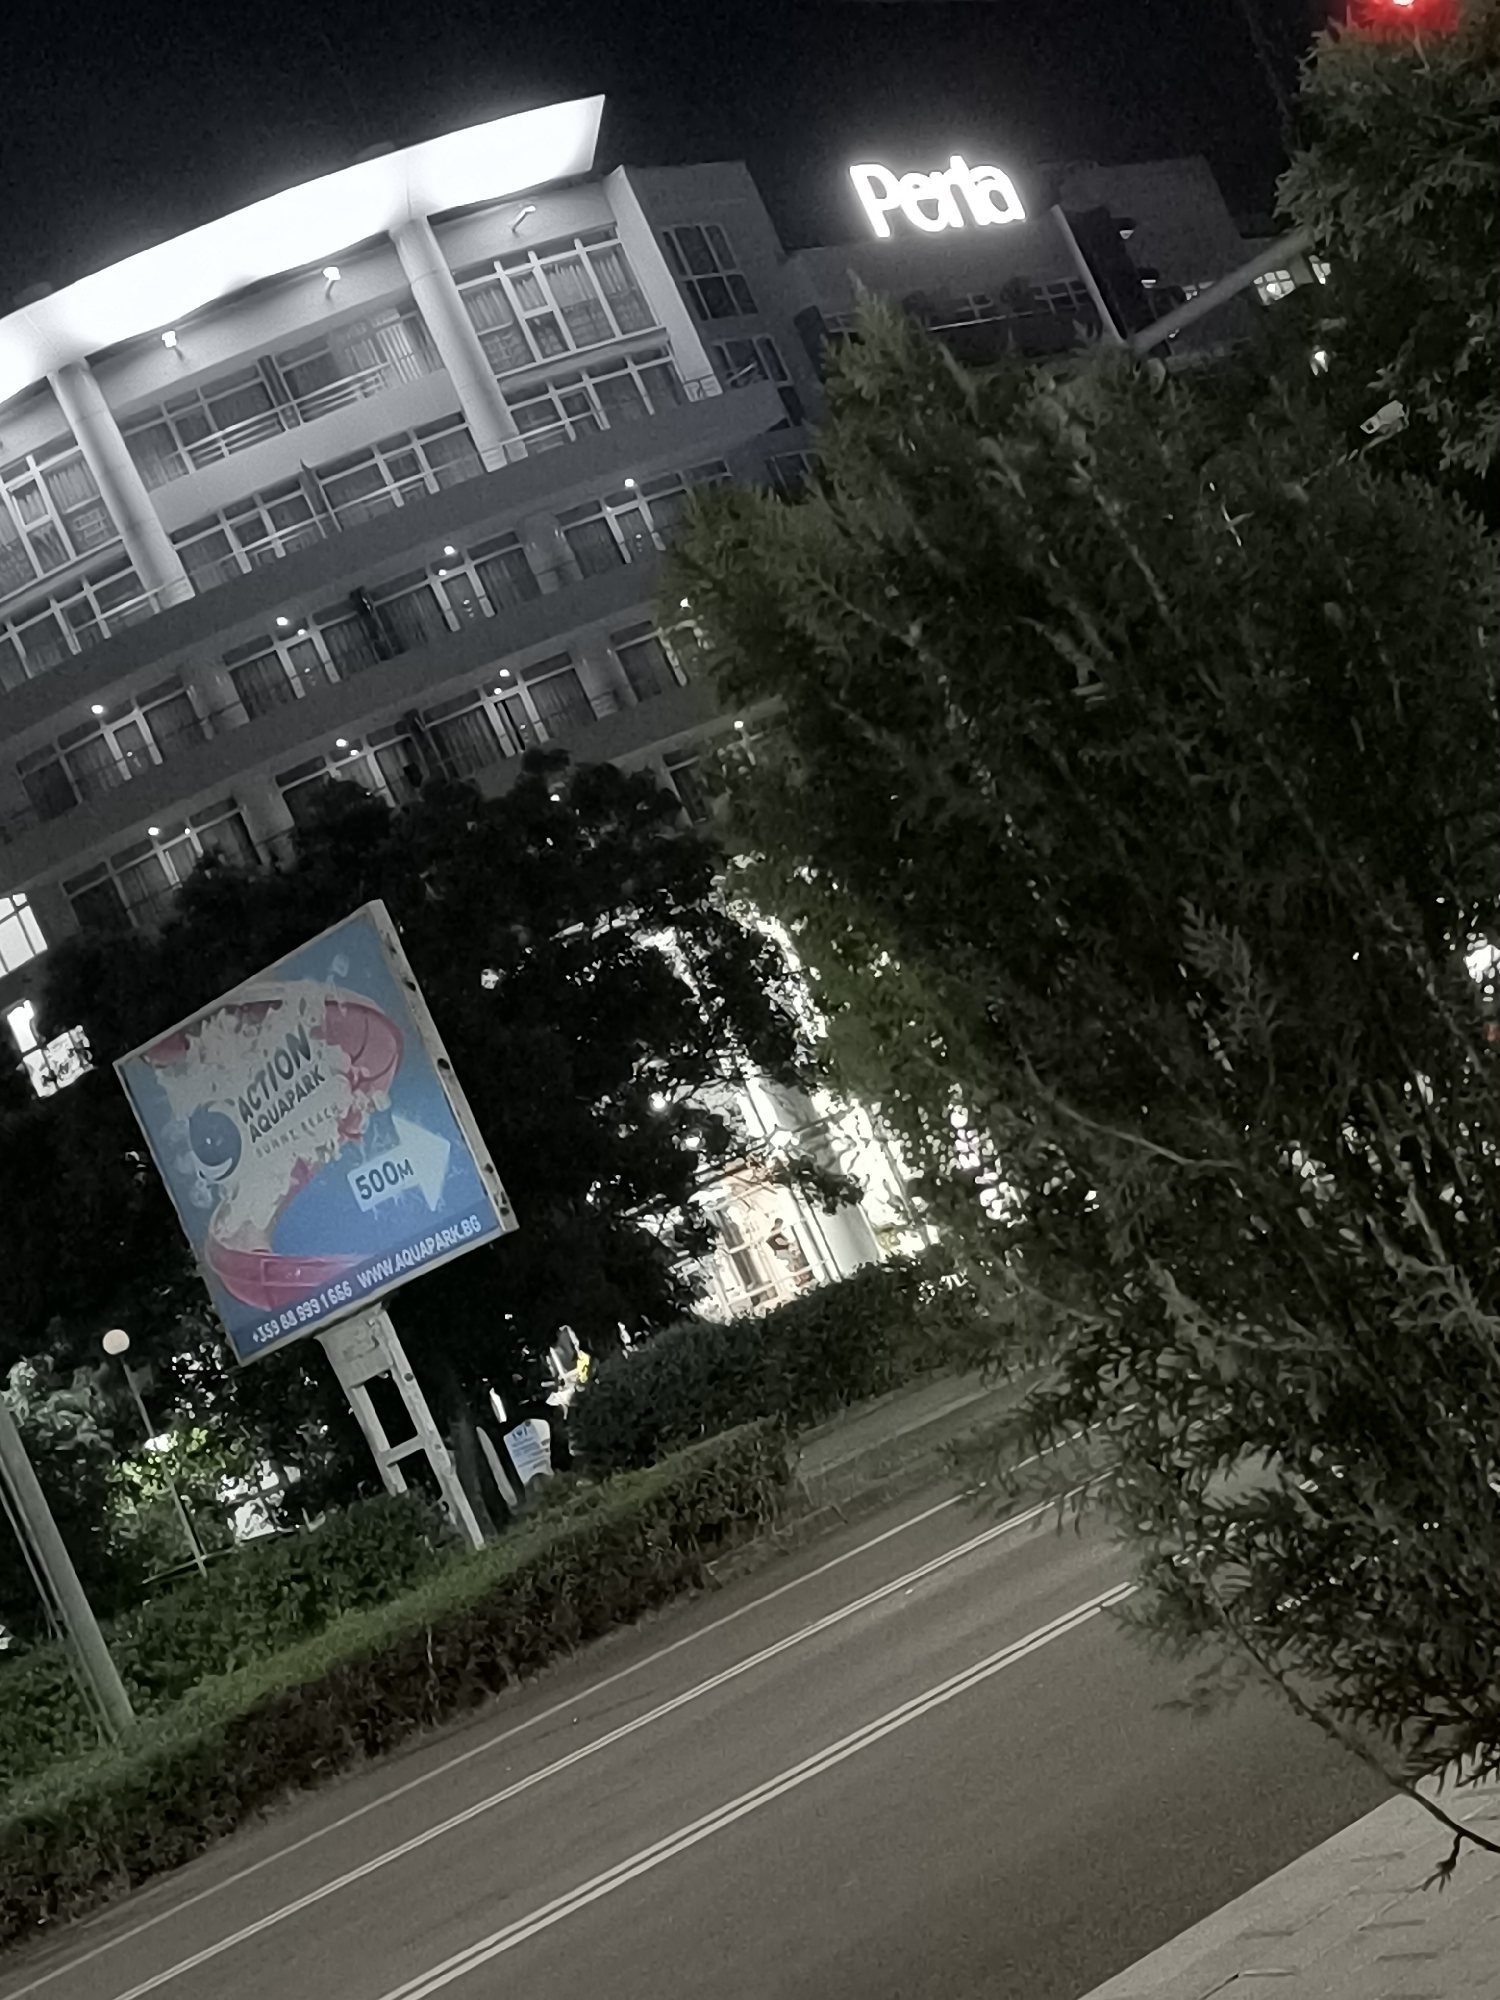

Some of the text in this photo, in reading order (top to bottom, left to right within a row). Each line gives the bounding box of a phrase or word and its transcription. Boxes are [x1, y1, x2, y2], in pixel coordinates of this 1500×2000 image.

[849, 155, 1026, 238] Perla
[238, 1022, 311, 1124] ACTION
[249, 1063, 326, 1143] AQUAPARK
[356, 1214, 482, 1289] WWW.AQUAPARK.BG
